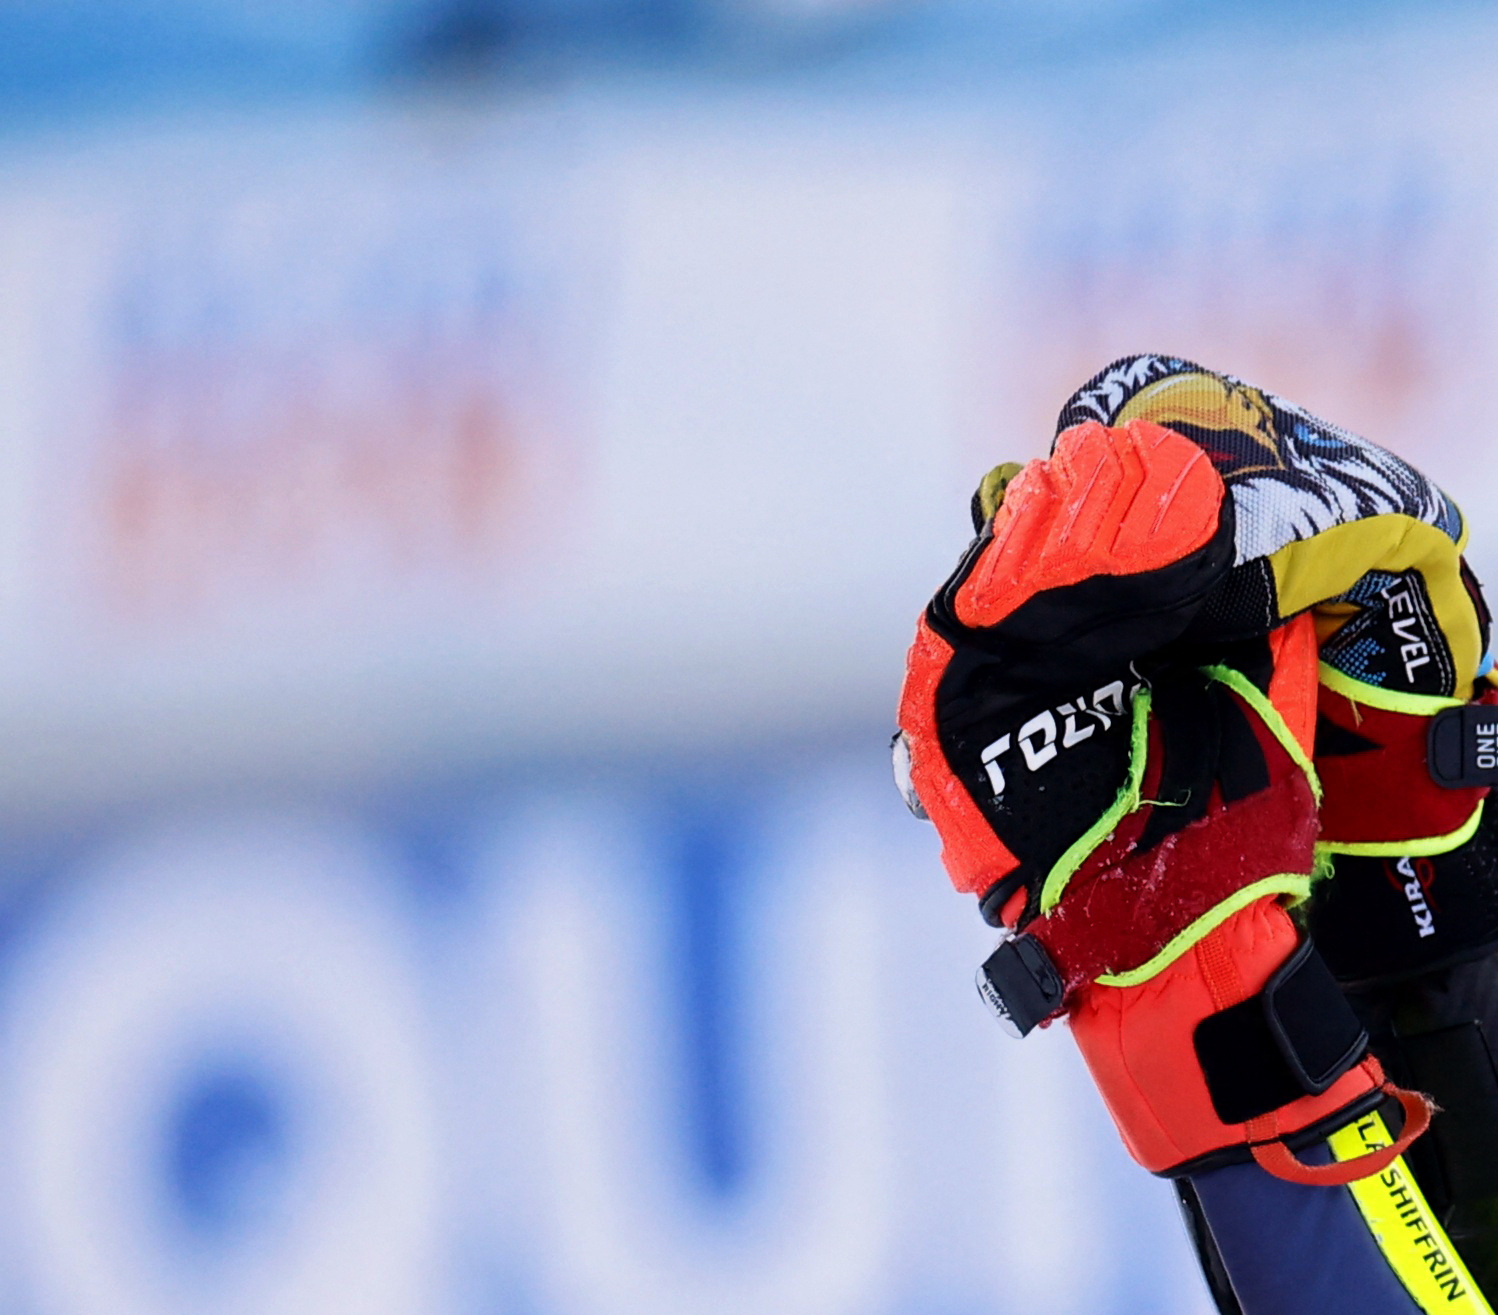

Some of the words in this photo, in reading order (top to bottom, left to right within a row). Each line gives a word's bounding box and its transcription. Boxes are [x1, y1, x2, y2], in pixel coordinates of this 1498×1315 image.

[1380, 577, 1431, 684] LEVEL
[1476, 722, 1495, 769] ONE
[1380, 1167, 1466, 1303] SHIFFRIN
